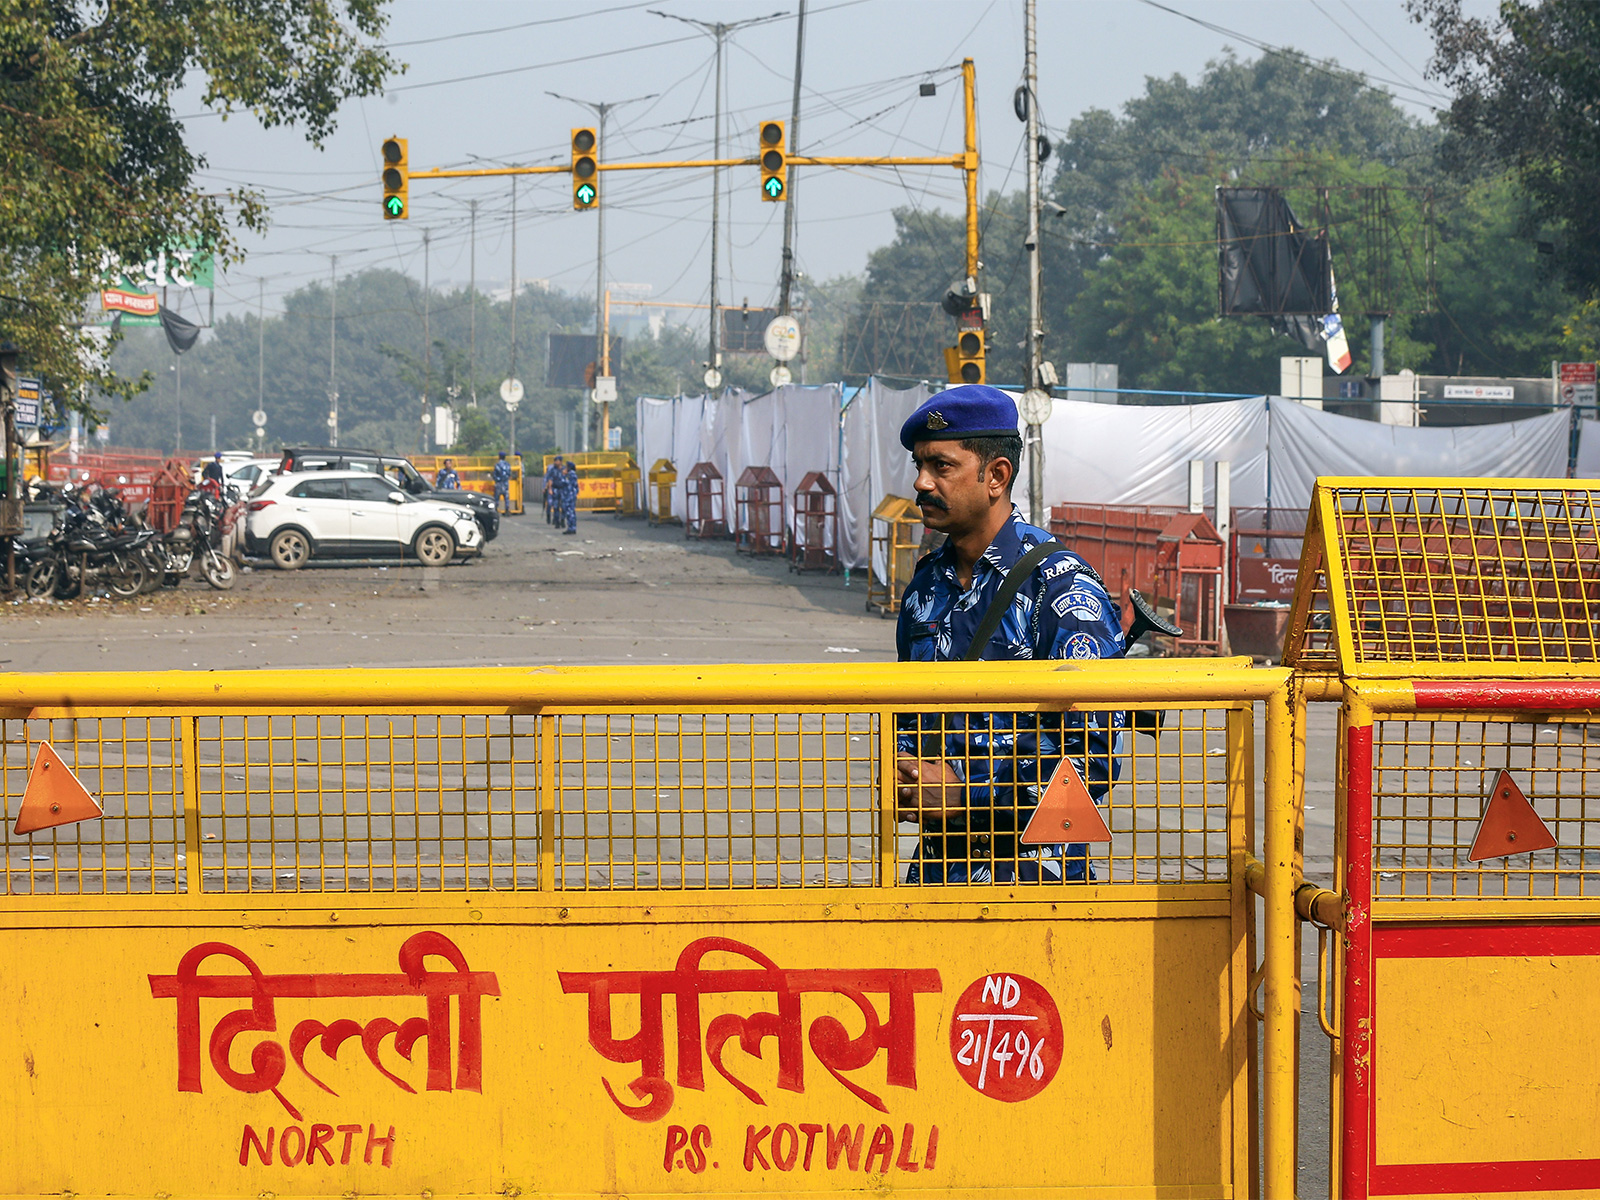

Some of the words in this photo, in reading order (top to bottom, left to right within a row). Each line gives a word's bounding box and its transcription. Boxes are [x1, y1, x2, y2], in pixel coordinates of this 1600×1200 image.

[981, 975, 1021, 1009] ND
[147, 931, 501, 1121] दिल्ली
[558, 936, 942, 1122] पुलिस
[239, 1124, 396, 1168] NORTH
[742, 1122, 940, 1175] KOTWALI
